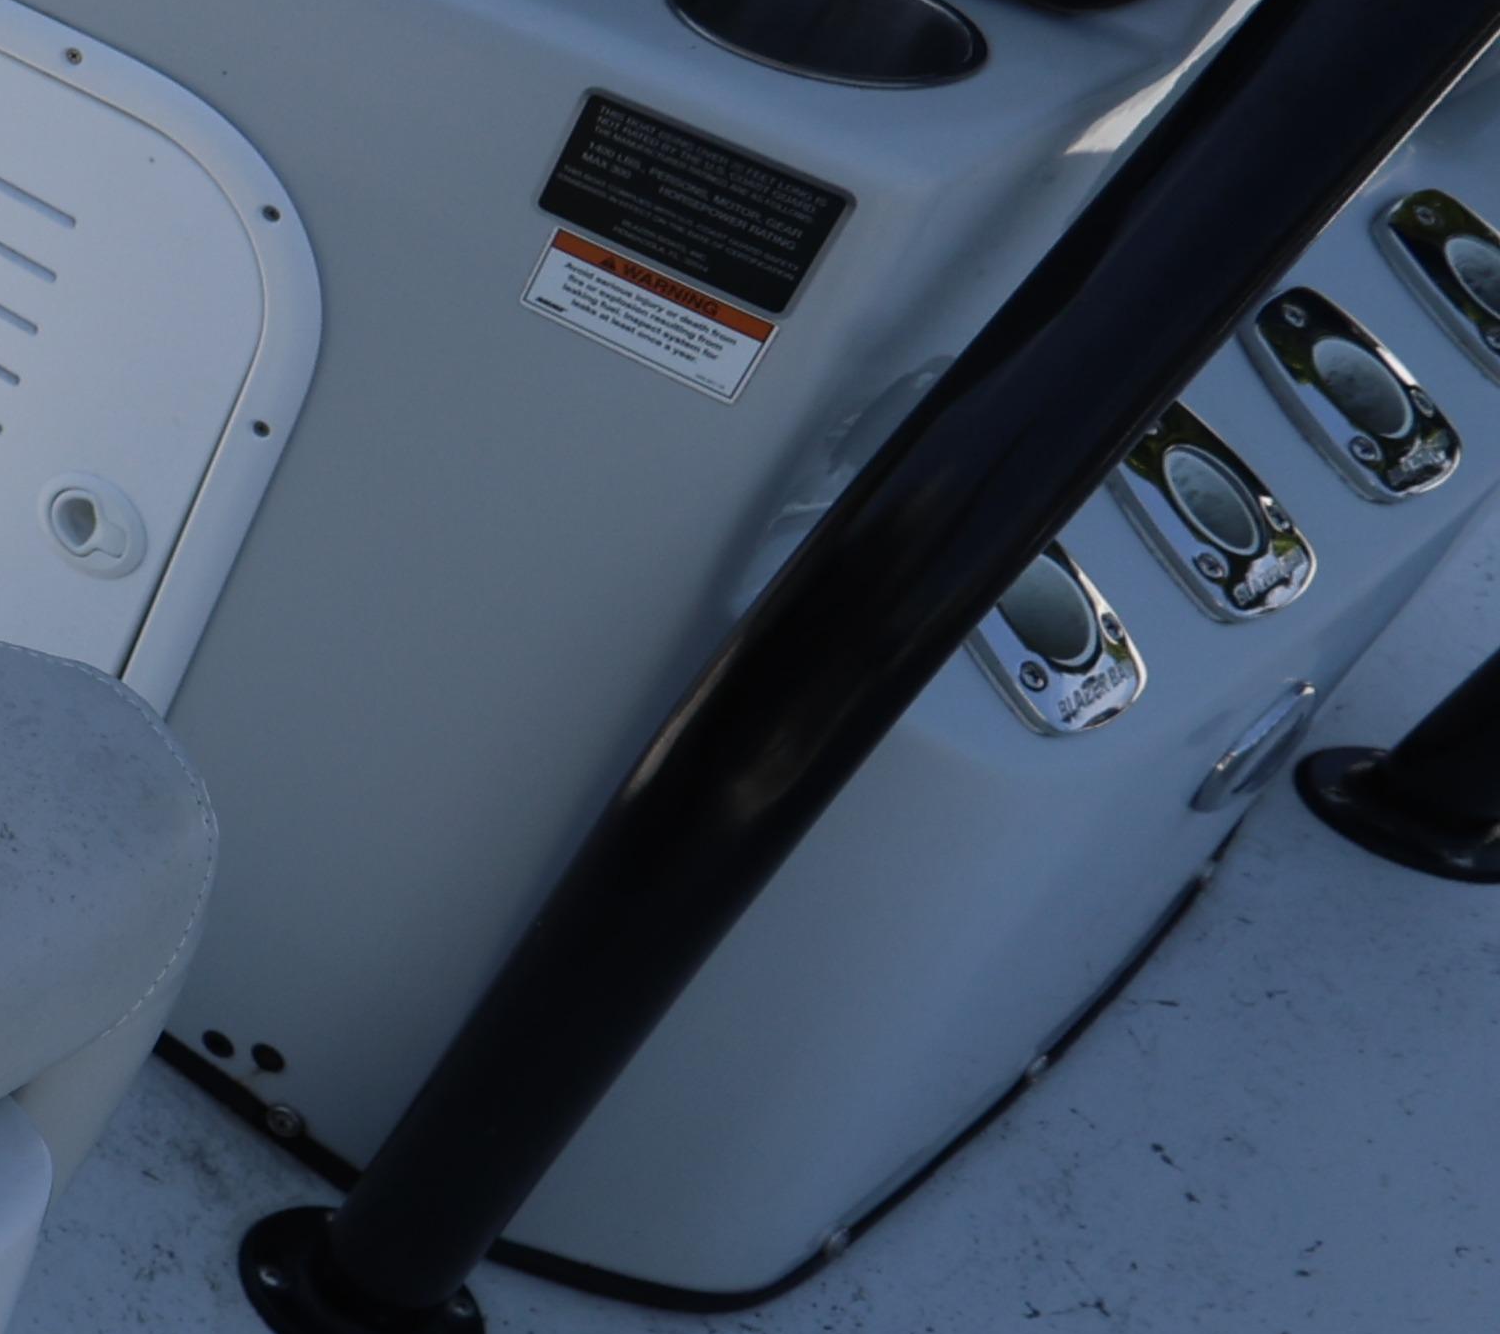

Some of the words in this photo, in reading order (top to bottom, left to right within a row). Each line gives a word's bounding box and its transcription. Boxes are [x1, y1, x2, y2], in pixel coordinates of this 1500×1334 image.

[561, 282, 598, 305] leaking
[623, 312, 661, 335] Inspect
[662, 331, 700, 353] system
[702, 349, 718, 360] for
[564, 261, 594, 279] Avoid
[595, 275, 633, 297] serious
[634, 293, 664, 314] injury
[679, 314, 710, 333] death
[710, 328, 737, 345] from
[567, 274, 585, 286] fire
[598, 289, 648, 317] explosion
[648, 312, 696, 340] resulting
[697, 335, 723, 351] from
[571, 298, 597, 315] leaks
[610, 317, 635, 333] least
[636, 330, 662, 347] once
[619, 262, 722, 317] WARNING
